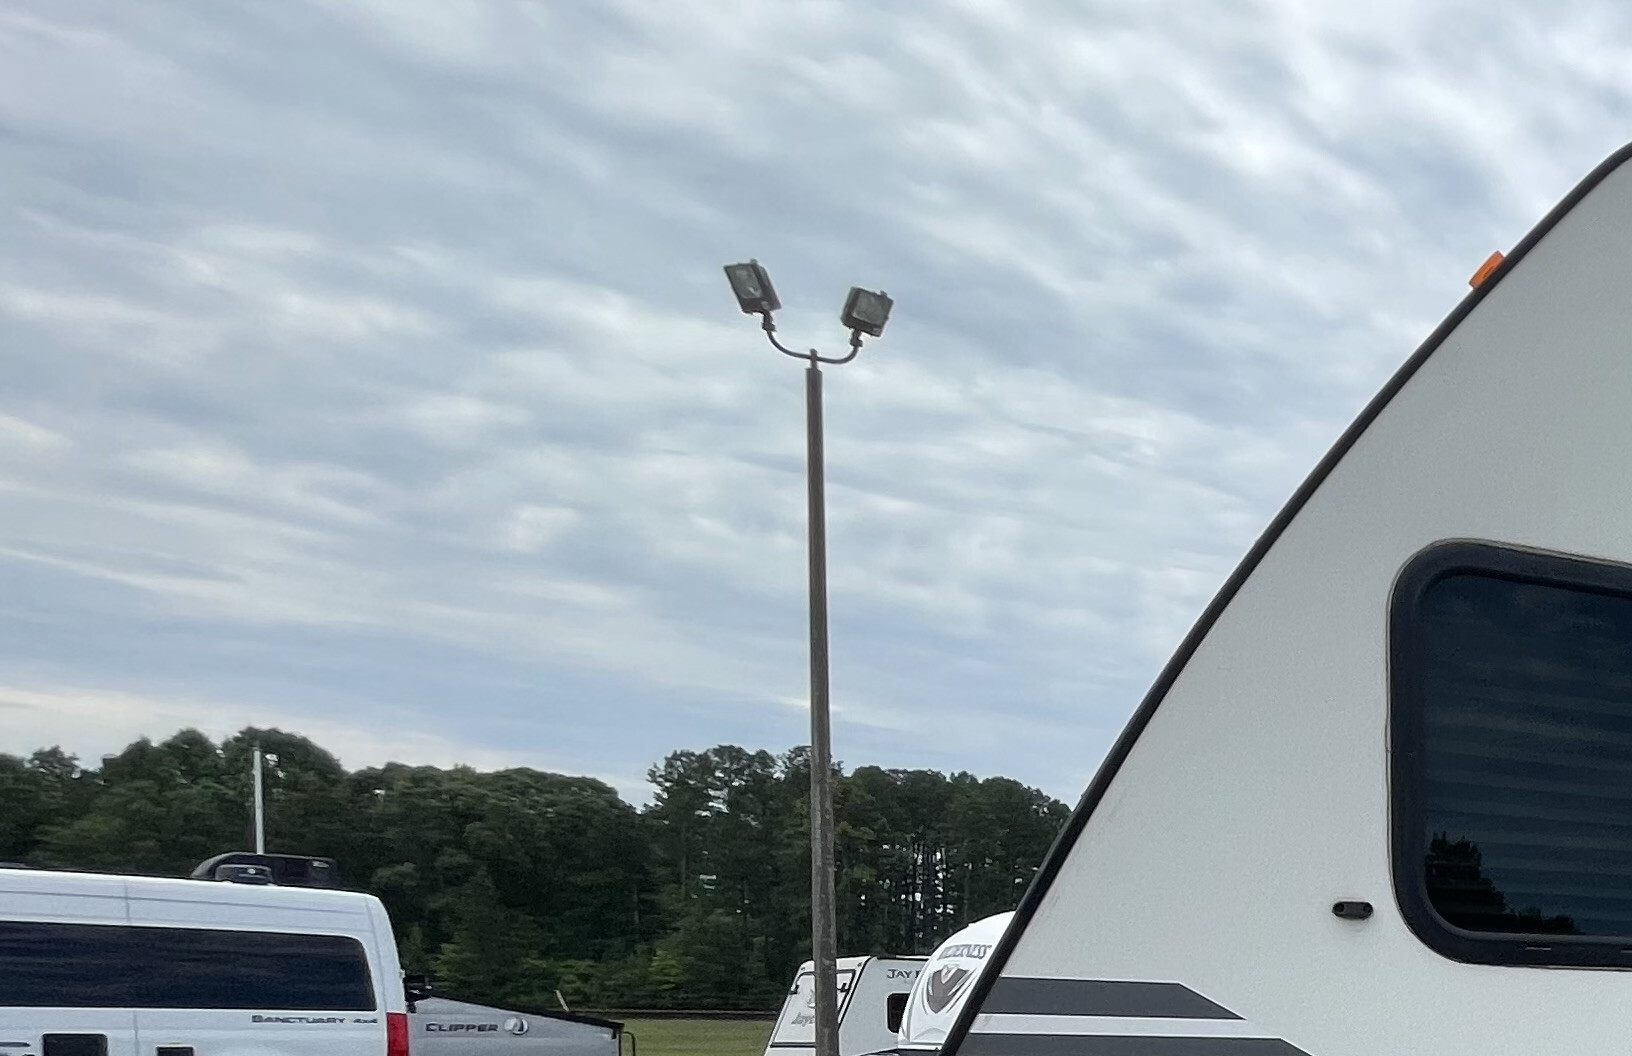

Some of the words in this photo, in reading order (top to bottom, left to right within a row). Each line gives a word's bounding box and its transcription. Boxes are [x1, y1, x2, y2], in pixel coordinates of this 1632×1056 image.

[887, 968, 912, 979] JAY
[251, 1014, 345, 1024] SANCTUARY
[425, 1022, 499, 1032] CLIPPER
